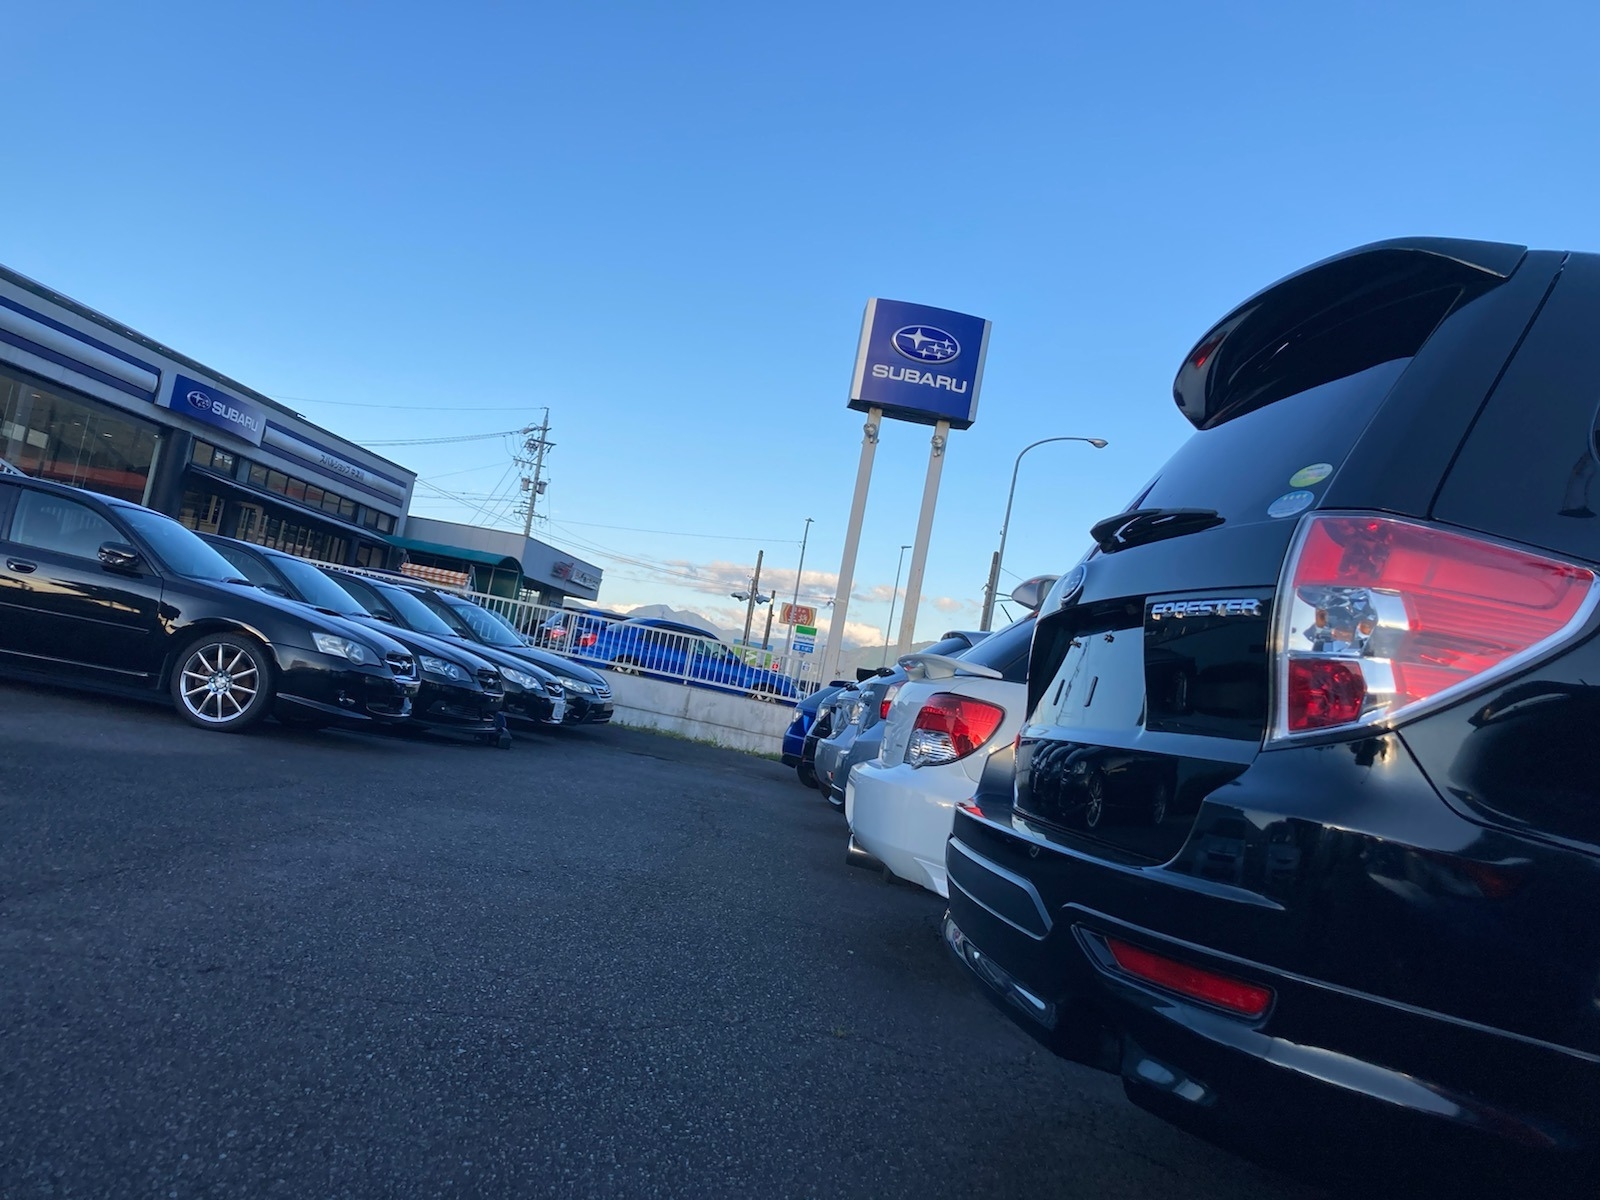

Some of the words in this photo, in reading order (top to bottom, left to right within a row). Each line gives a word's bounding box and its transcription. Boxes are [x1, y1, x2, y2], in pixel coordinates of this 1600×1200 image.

[872, 364, 968, 394] SUBARU
[211, 400, 259, 432] SUBARU
[1151, 599, 1262, 620] FORESTER
